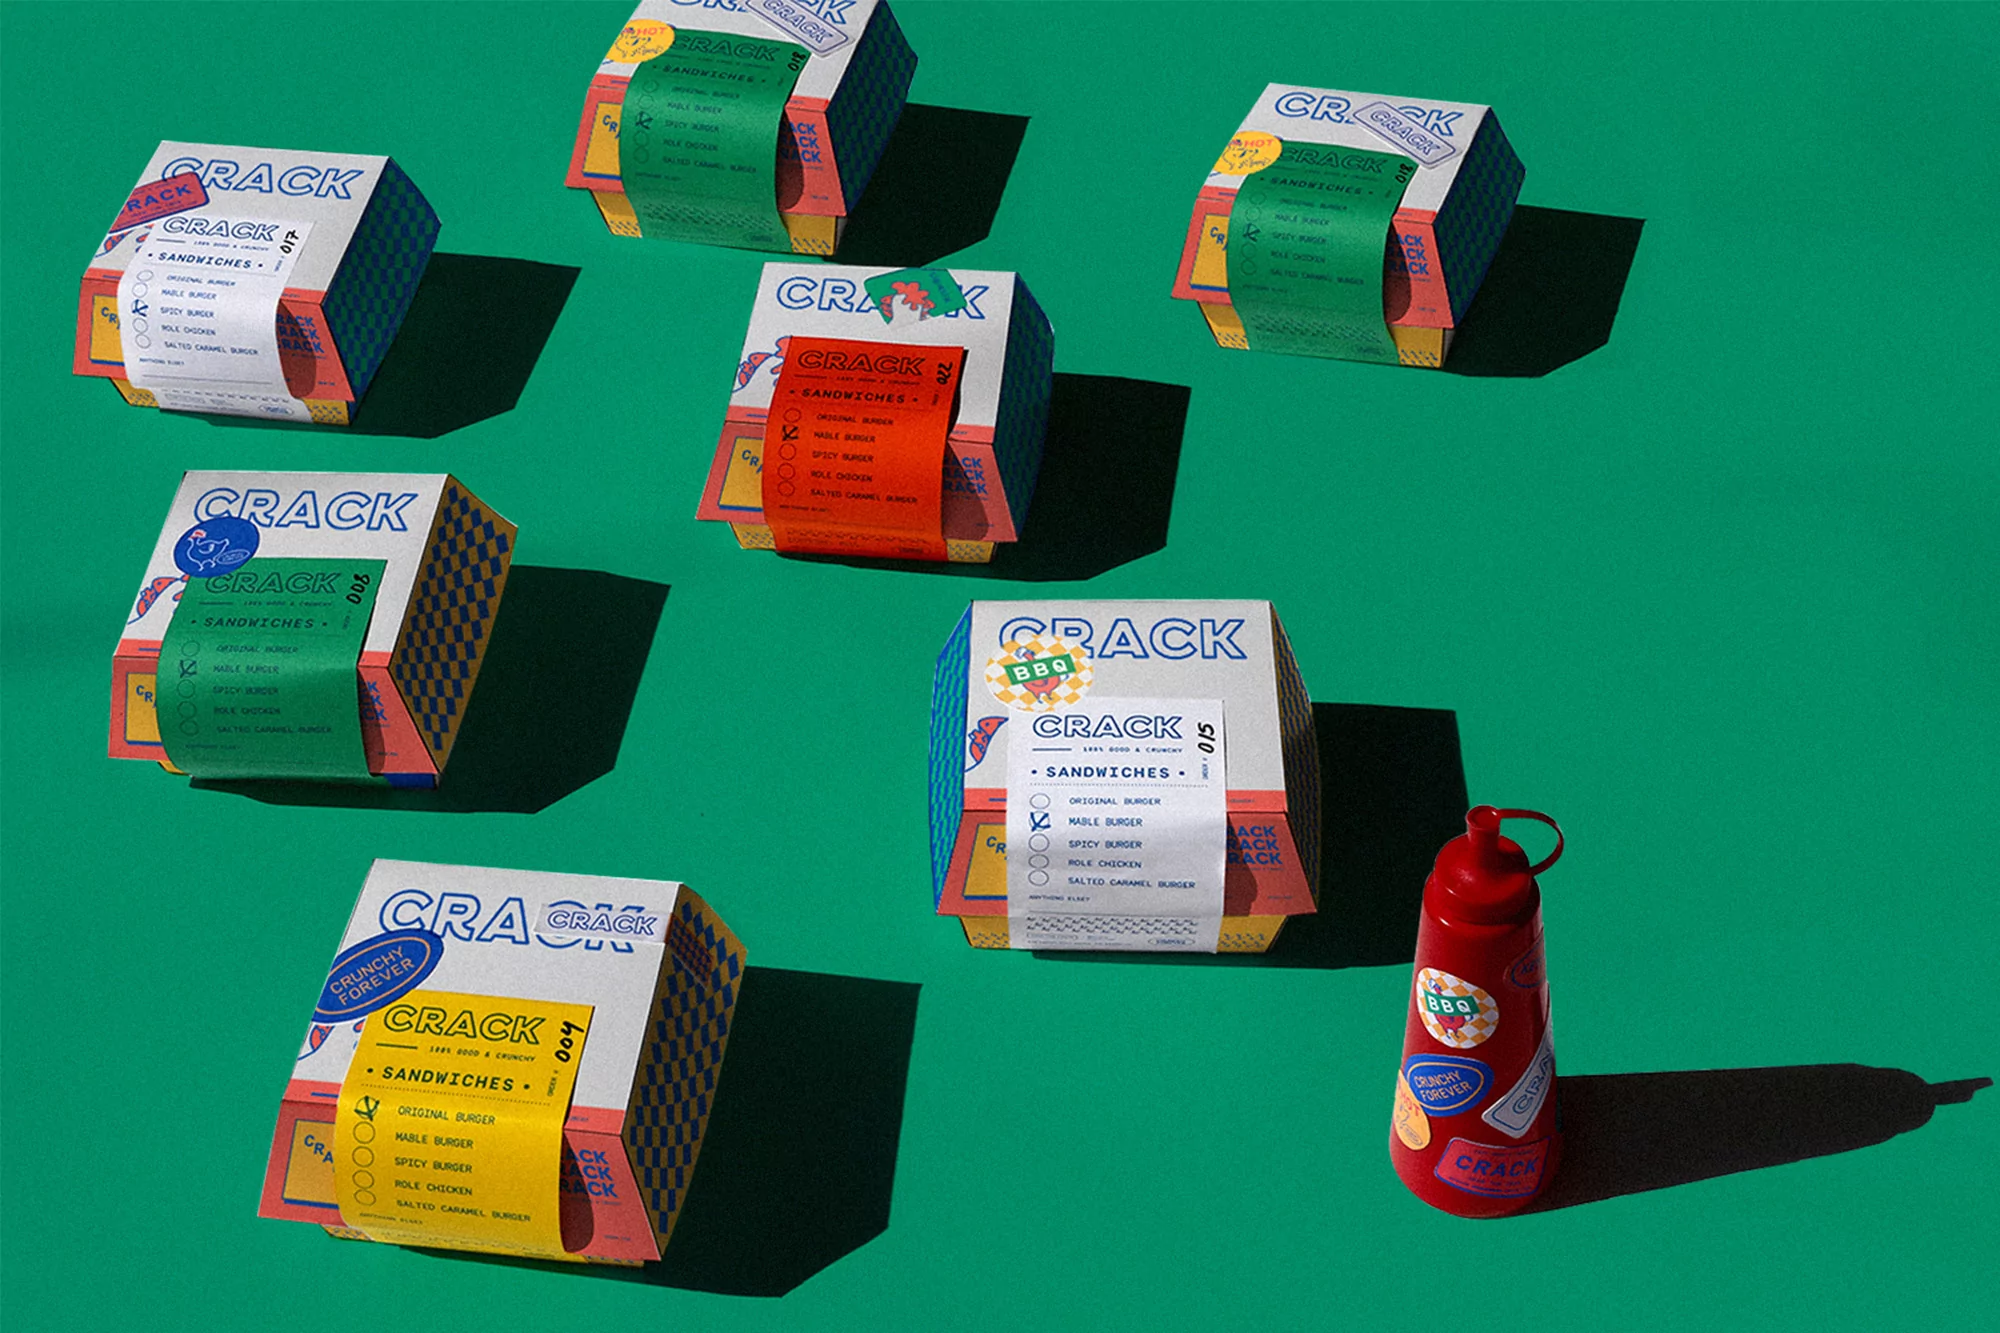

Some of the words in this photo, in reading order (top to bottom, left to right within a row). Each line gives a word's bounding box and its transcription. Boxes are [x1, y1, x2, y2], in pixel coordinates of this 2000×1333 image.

[762, 0, 834, 44] CRACK
[636, 27, 668, 36] HOT
[673, 35, 780, 61] CRACK
[787, 51, 806, 72] 018
[662, 64, 754, 83] SANDWICHES
[1274, 91, 1465, 137] CRK
[1369, 109, 1441, 156] CRACK
[1243, 139, 1275, 148] HOT
[1282, 147, 1388, 174] CRACK
[161, 157, 365, 200] CRACK
[1395, 163, 1414, 184] 018
[1270, 178, 1363, 195] SANDWICHES
[120, 184, 192, 215] RACK
[163, 216, 280, 241] CRACK
[280, 229, 299, 254] 017
[158, 252, 252, 269] SANDWICHES
[166, 275, 203, 284] ORIGINAL
[207, 279, 236, 287] BURGER
[161, 289, 186, 299] MABLE
[188, 291, 217, 300] BURGER
[776, 276, 989, 319] CRK
[160, 306, 183, 316] SPICY
[187, 309, 214, 318] BURGER
[161, 325, 180, 333] ROLE
[184, 327, 216, 336] CHICKEN
[276, 325, 320, 340] RACK
[164, 341, 191, 351] SALTED
[195, 343, 226, 354] CARAMEL
[230, 346, 259, 356] BURGER
[798, 350, 926, 376] CRACK
[802, 387, 905, 403] SANDWICHES
[816, 413, 857, 425] ORIGINAL
[862, 415, 894, 426] BURGER
[813, 431, 840, 441] MABLE
[844, 432, 876, 443] BURGER
[811, 450, 838, 460] SPICY
[842, 452, 874, 463] BURGER
[810, 469, 832, 480] ROLE
[835, 471, 873, 483] CHICKEN
[810, 487, 842, 498] SALTED
[846, 490, 882, 501] CARAMEL
[885, 492, 919, 504] BURGER
[944, 482, 988, 495] RACK
[194, 487, 419, 532] CRACK
[205, 571, 341, 594] CRACK
[204, 617, 314, 629] SANDWICHES
[999, 617, 1248, 660] CRACK
[1012, 659, 1069, 682] BBQ
[1032, 714, 1183, 739] CRACK
[1197, 722, 1215, 754] 015
[1046, 766, 1170, 779] SANDWICHES
[1069, 797, 1118, 806] ORIGINAL
[1123, 797, 1161, 806] BURGER
[1068, 817, 1100, 827] MABLE
[1105, 817, 1143, 827] BURGER
[1226, 825, 1277, 837] RACK
[1068, 839, 1100, 849] SPICY
[1105, 839, 1143, 850] BURGER
[1226, 838, 1280, 851] RACK
[1068, 859, 1093, 867] ROLE
[1098, 860, 1142, 869] CHICKEN
[1227, 852, 1283, 865] RACK
[1068, 877, 1105, 886] SALTED
[1109, 879, 1152, 888] CARAMEL
[1158, 880, 1196, 889] BURGER
[547, 910, 658, 937] CRACK
[329, 946, 405, 995] CRUNCHY
[338, 957, 416, 1006] FOREVER
[1427, 995, 1472, 1013] BBQ
[383, 1004, 547, 1046] CRACK
[496, 1052, 536, 1062] CRUNCHY
[382, 1066, 514, 1092] SANDWICHES
[1413, 1070, 1462, 1088] CRUNCHY
[1512, 1047, 1553, 1114] CRA
[1419, 1081, 1473, 1102] FOREVER
[397, 1105, 450, 1121] ORIGINAL
[455, 1110, 496, 1126] BURGER
[395, 1132, 428, 1145] MABLE
[434, 1135, 474, 1149] BURGER
[394, 1157, 427, 1170] SPICY
[432, 1160, 472, 1174] BURGER
[1455, 1155, 1539, 1177] CRACK
[394, 1180, 421, 1192] ROLE
[426, 1183, 472, 1196] CHICKEN
[560, 1178, 618, 1198] RACK
[396, 1199, 435, 1211] SALTED
[440, 1204, 486, 1218] CARAMEL
[492, 1208, 531, 1222] BURGER
